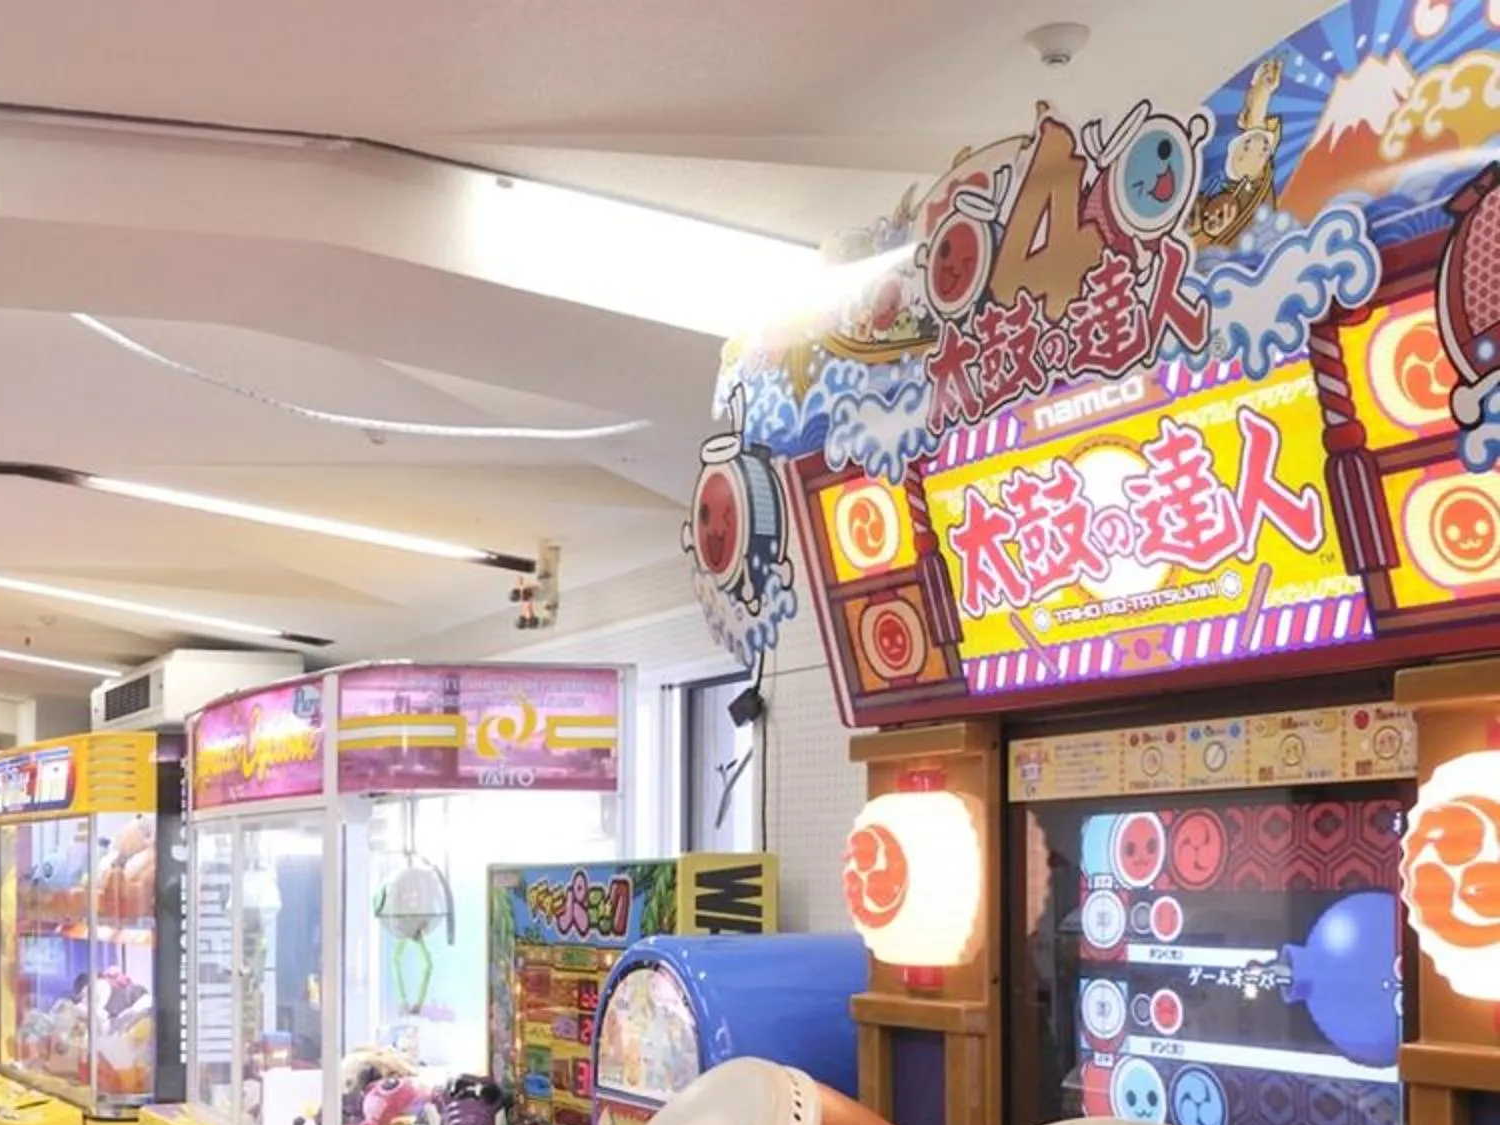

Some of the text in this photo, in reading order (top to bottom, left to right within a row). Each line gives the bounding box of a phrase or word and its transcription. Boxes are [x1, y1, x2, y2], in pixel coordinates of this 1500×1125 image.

[987, 115, 1100, 322] 4
[926, 234, 1211, 437] 太鼓の達人
[1034, 376, 1145, 431] namco
[948, 405, 1326, 619] 太鼓の達人
[476, 766, 536, 786] TAITO
[1189, 967, 1291, 990] ゲームオーバー
